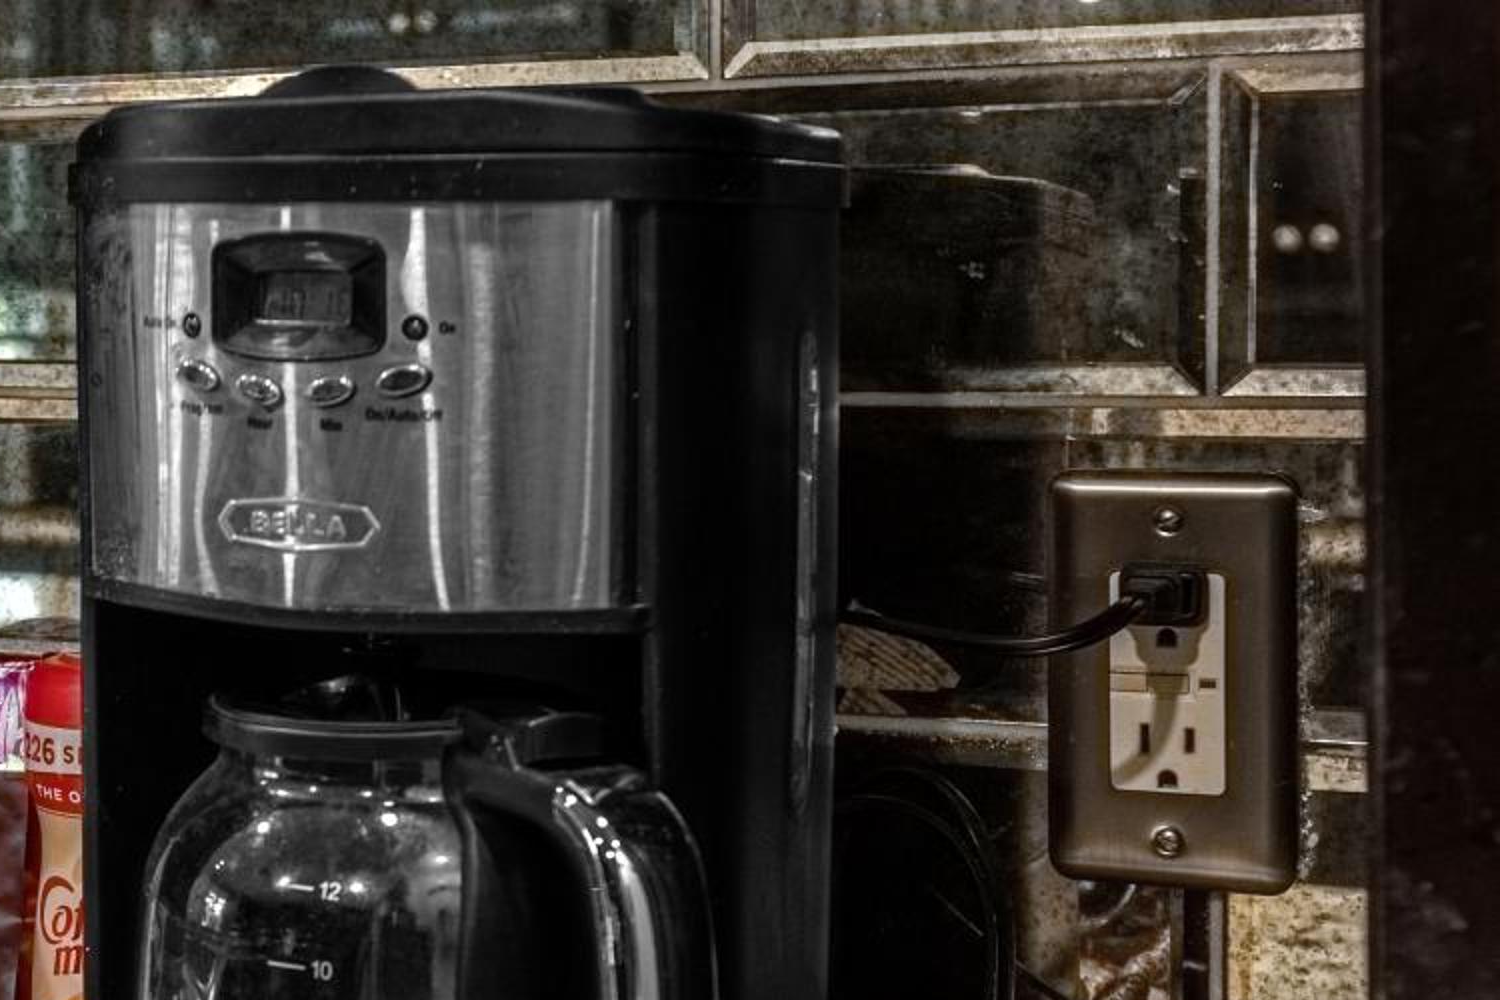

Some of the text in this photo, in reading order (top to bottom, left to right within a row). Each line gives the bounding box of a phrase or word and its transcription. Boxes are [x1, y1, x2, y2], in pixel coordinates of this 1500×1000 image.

[249, 510, 347, 539] BELLA
[35, 783, 63, 801] THE
[319, 881, 341, 902] 12
[311, 960, 334, 982] 10
